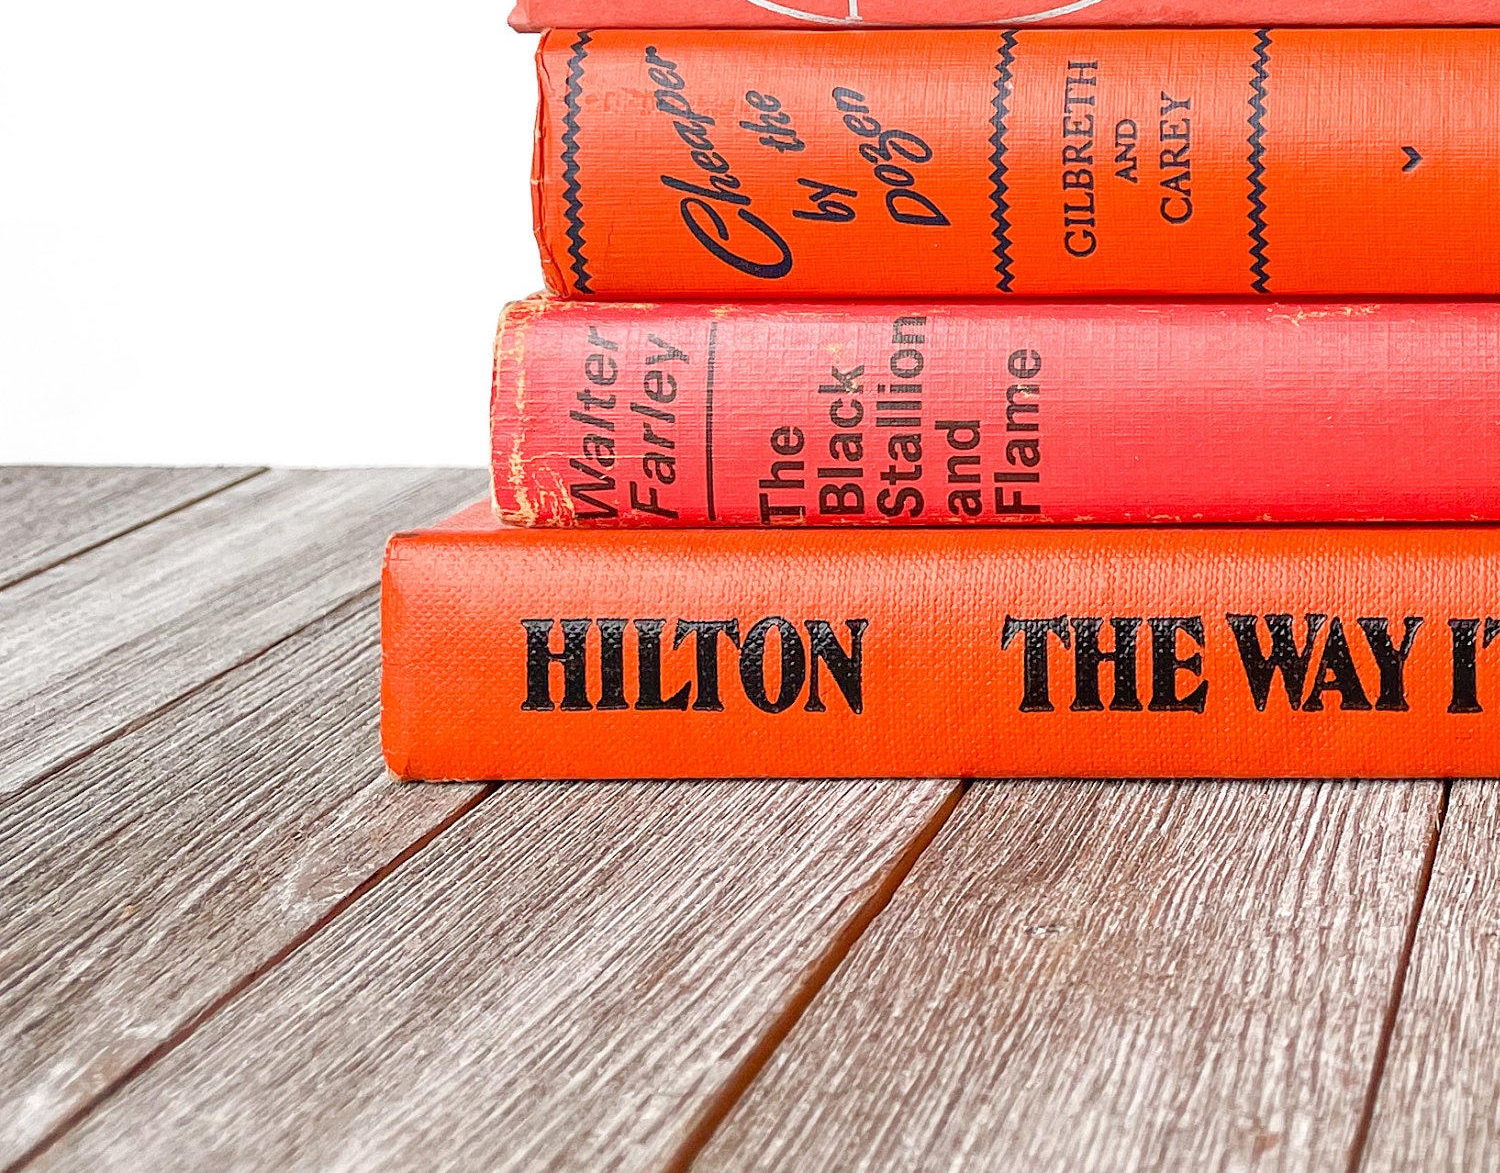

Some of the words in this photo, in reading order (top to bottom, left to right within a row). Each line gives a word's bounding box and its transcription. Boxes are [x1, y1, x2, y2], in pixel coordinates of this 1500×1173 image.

[645, 44, 794, 280] Cheaper
[740, 91, 804, 152] the
[831, 86, 952, 227] Dozen
[1062, 59, 1100, 258] GILBRETH
[1115, 119, 1137, 183] AND
[1160, 92, 1192, 223] CAREY
[793, 178, 857, 222] by
[569, 325, 619, 522] Walter
[629, 332, 690, 521] Farley
[758, 426, 806, 523] The
[818, 366, 864, 514] Black
[877, 317, 926, 517] Stallion
[935, 421, 982, 516] and
[994, 350, 1041, 514] Flame
[521, 616, 869, 714] HILTON
[1001, 614, 1207, 714] THE
[1226, 612, 1424, 712] WAY
